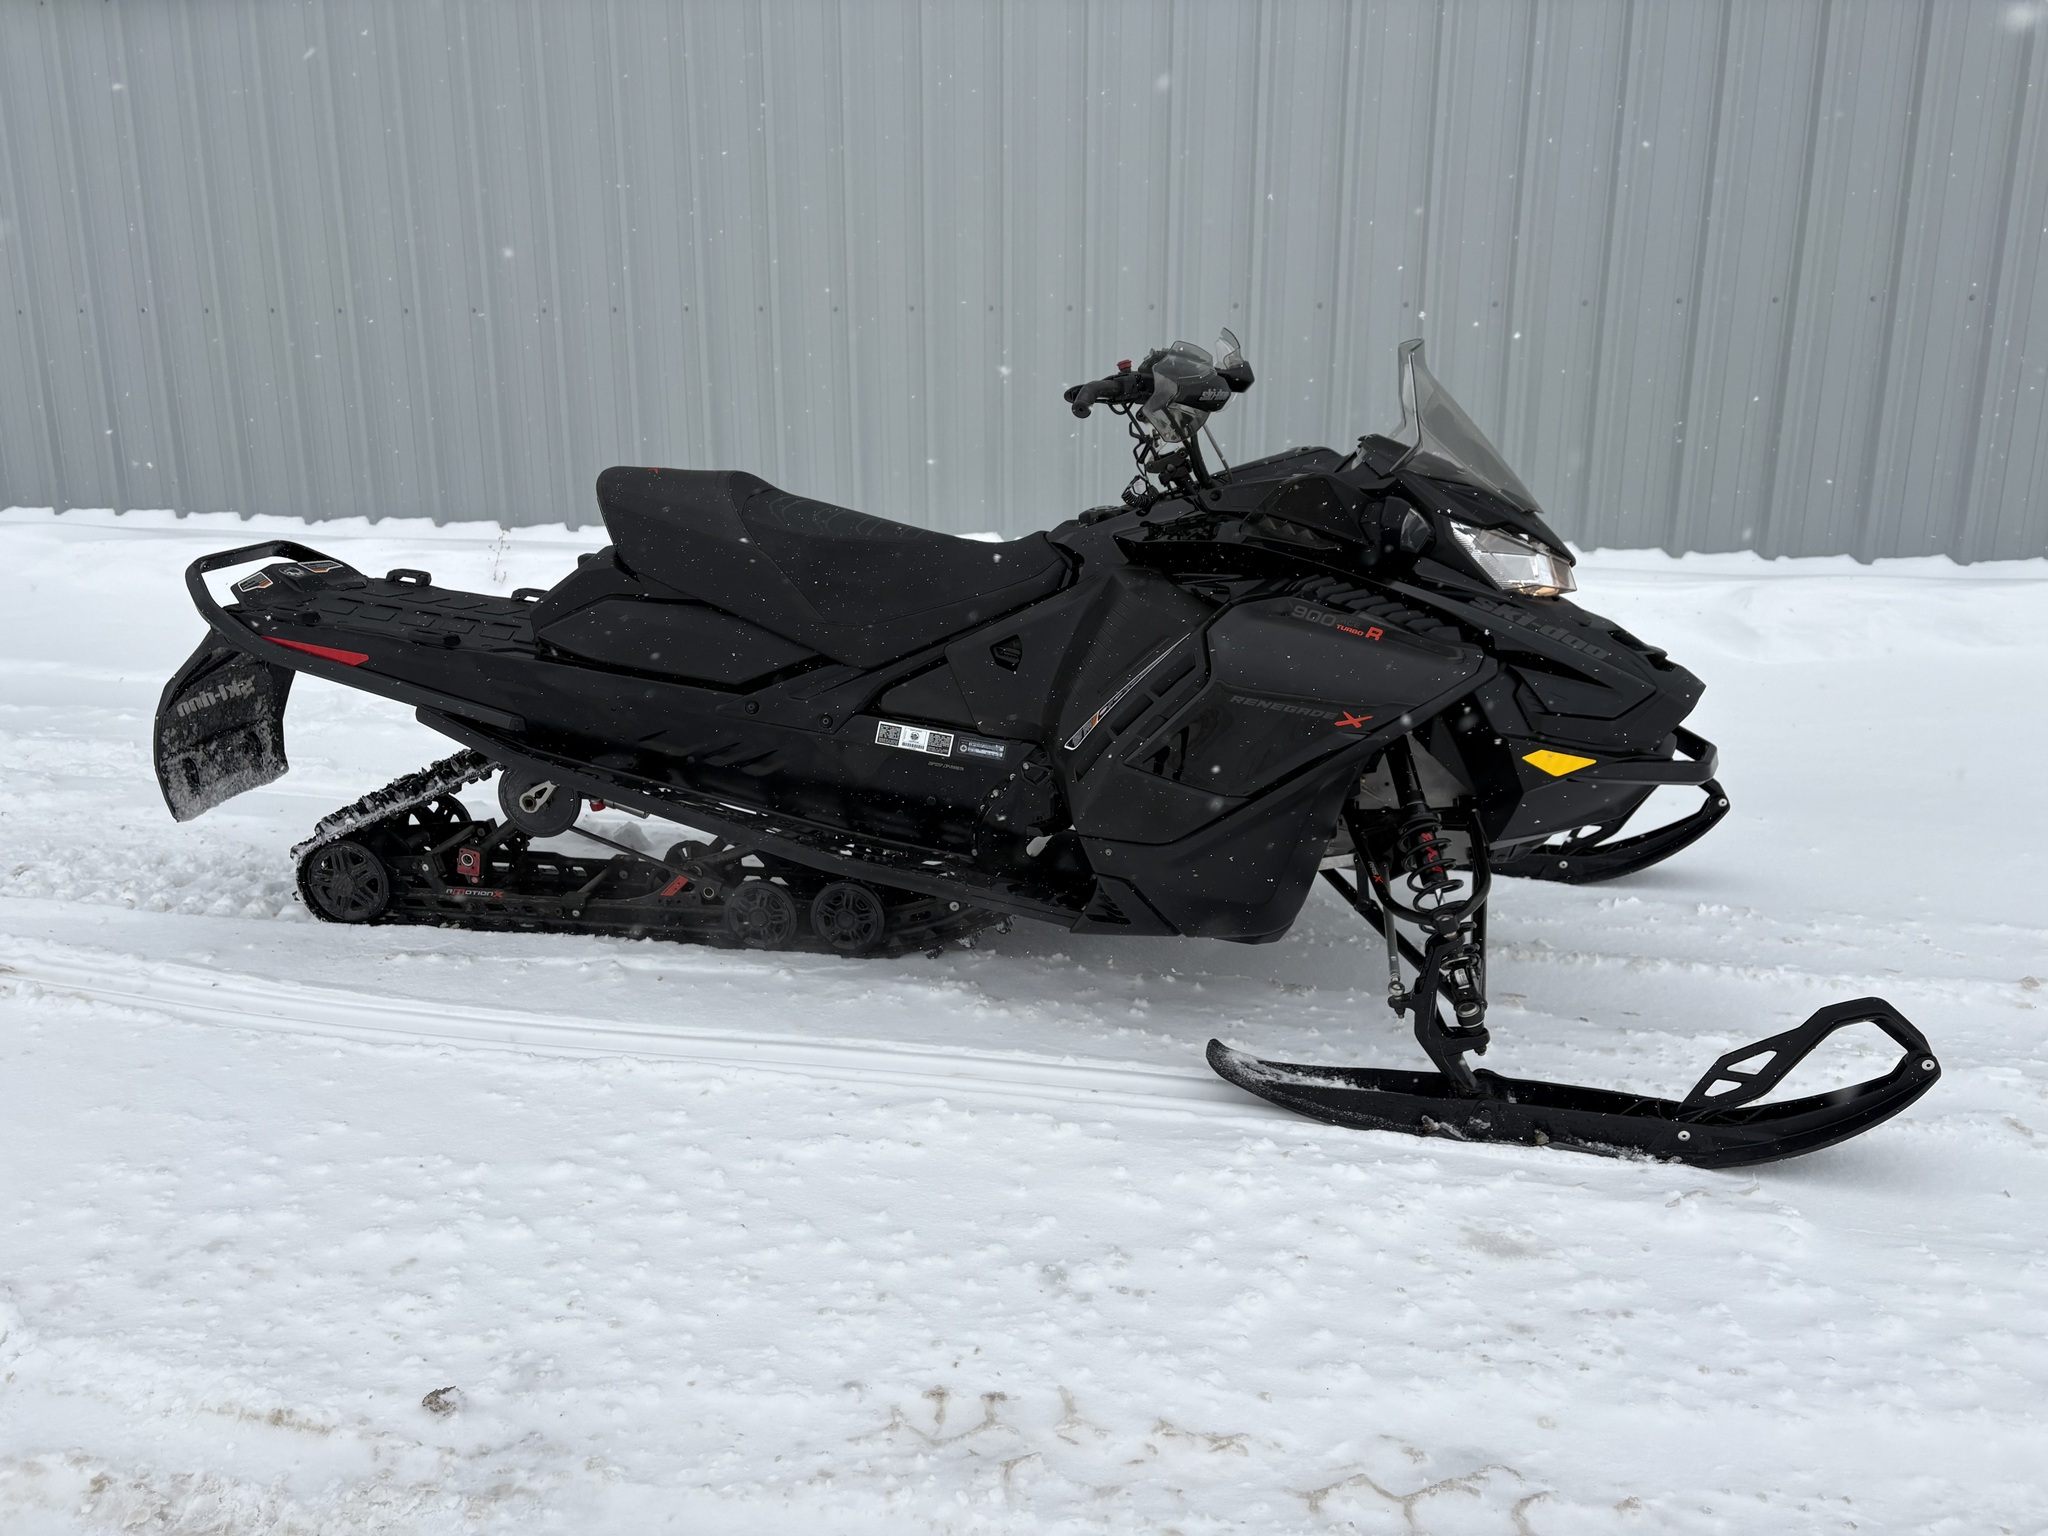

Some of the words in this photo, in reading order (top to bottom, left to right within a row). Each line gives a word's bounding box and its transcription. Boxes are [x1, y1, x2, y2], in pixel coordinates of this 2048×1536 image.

[1291, 605, 1337, 626] 900
[1336, 623, 1364, 637] TURBO
[1365, 626, 1385, 641] R
[1229, 695, 1339, 720] RENEGADE
[1334, 711, 1374, 729] X
